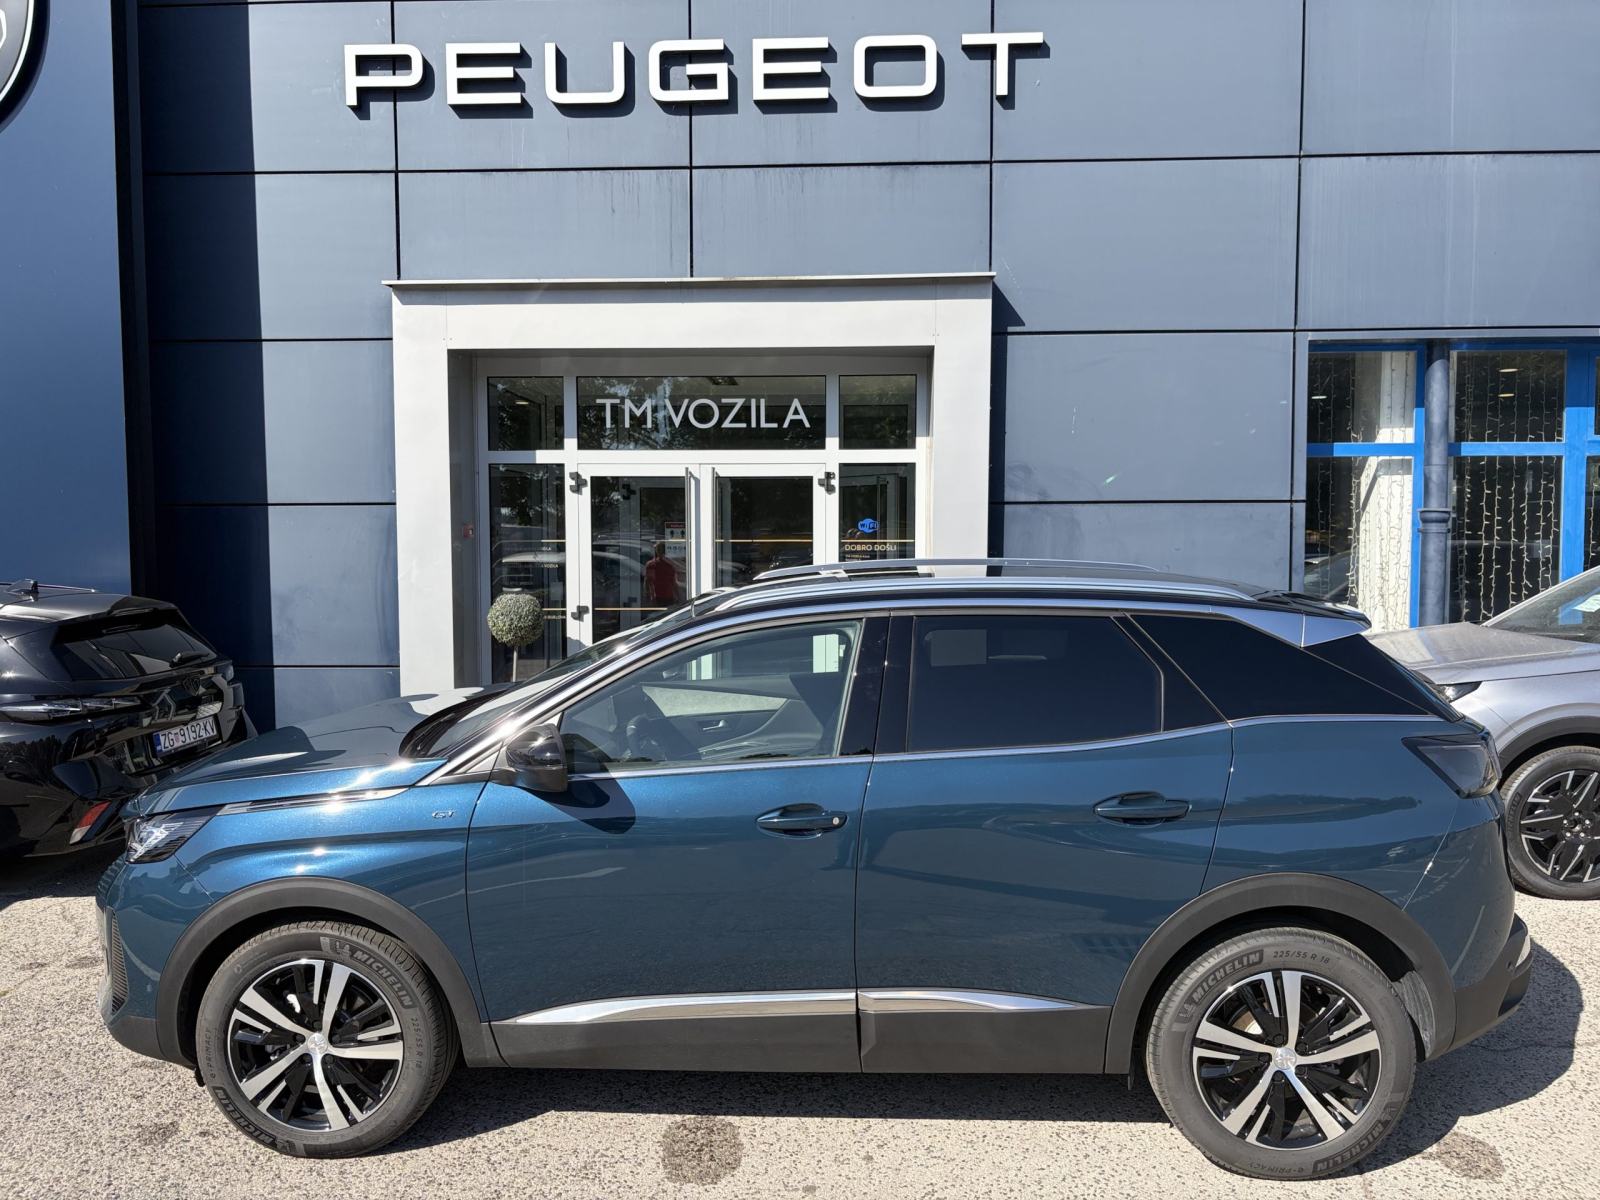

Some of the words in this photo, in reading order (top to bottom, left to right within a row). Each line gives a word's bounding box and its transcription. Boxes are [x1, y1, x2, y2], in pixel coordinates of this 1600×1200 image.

[344, 32, 1043, 106] PEUGEOT
[596, 398, 652, 428] TM
[665, 398, 811, 428] VOZILA
[874, 542, 897, 551] DOŠLI
[160, 731, 175, 750] ZG
[353, 949, 414, 1009] MICHELIN
[1194, 952, 1261, 1003] MICHELIN
[1273, 950, 1308, 959] 225/55
[1319, 955, 1331, 965] 18
[215, 1089, 276, 1144] MICHELIN
[1316, 1122, 1385, 1172] MICHELIN
